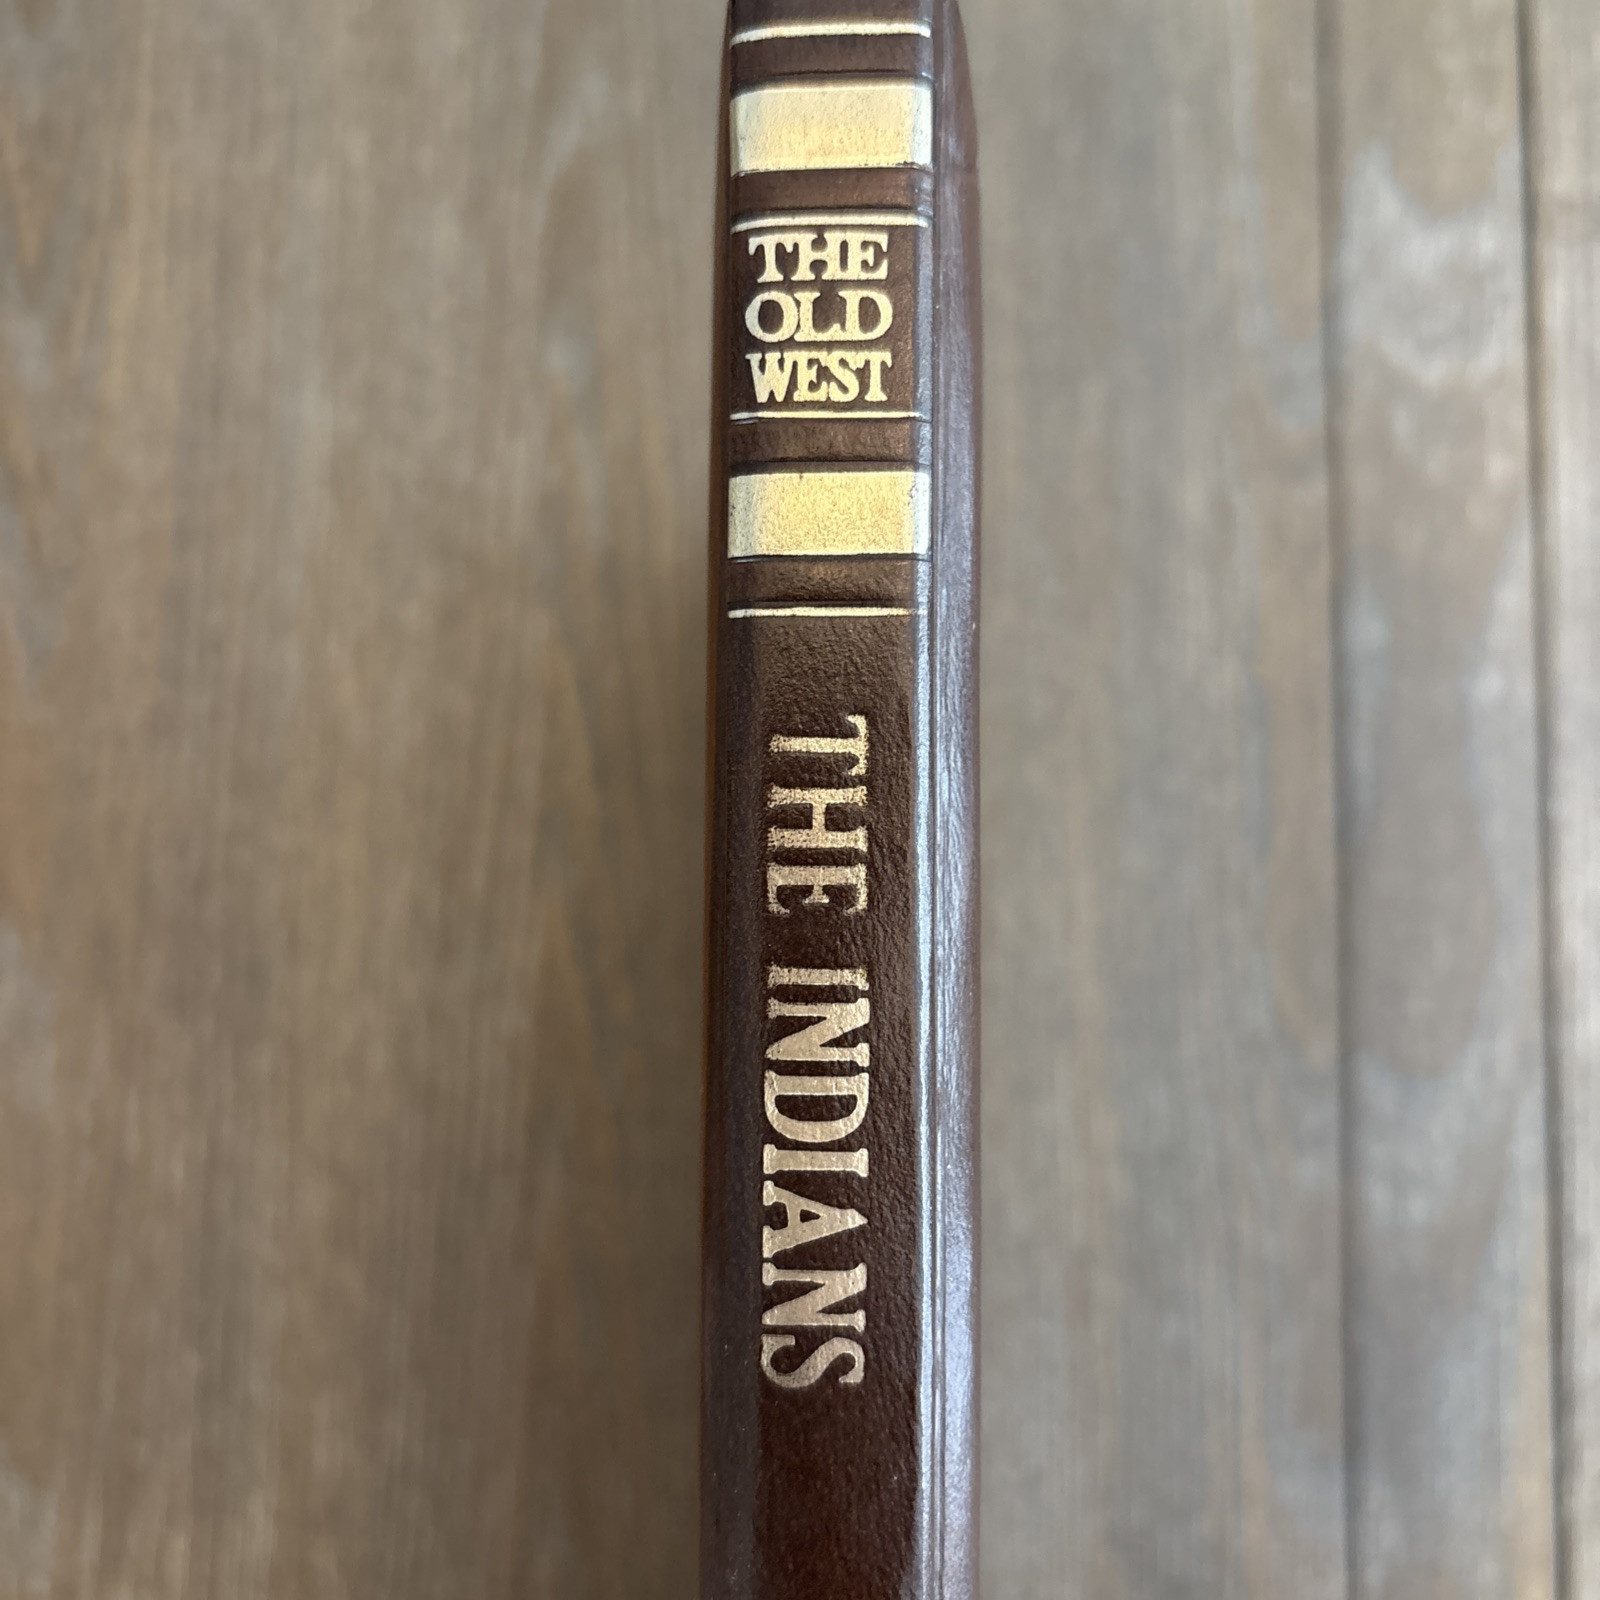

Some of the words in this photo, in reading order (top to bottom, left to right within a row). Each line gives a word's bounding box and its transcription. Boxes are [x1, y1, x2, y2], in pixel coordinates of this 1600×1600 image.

[748, 230, 889, 284] THE
[744, 289, 893, 343] OLD
[745, 350, 893, 404] WEST
[766, 713, 870, 916] THE
[761, 965, 871, 1389] INDIANS
